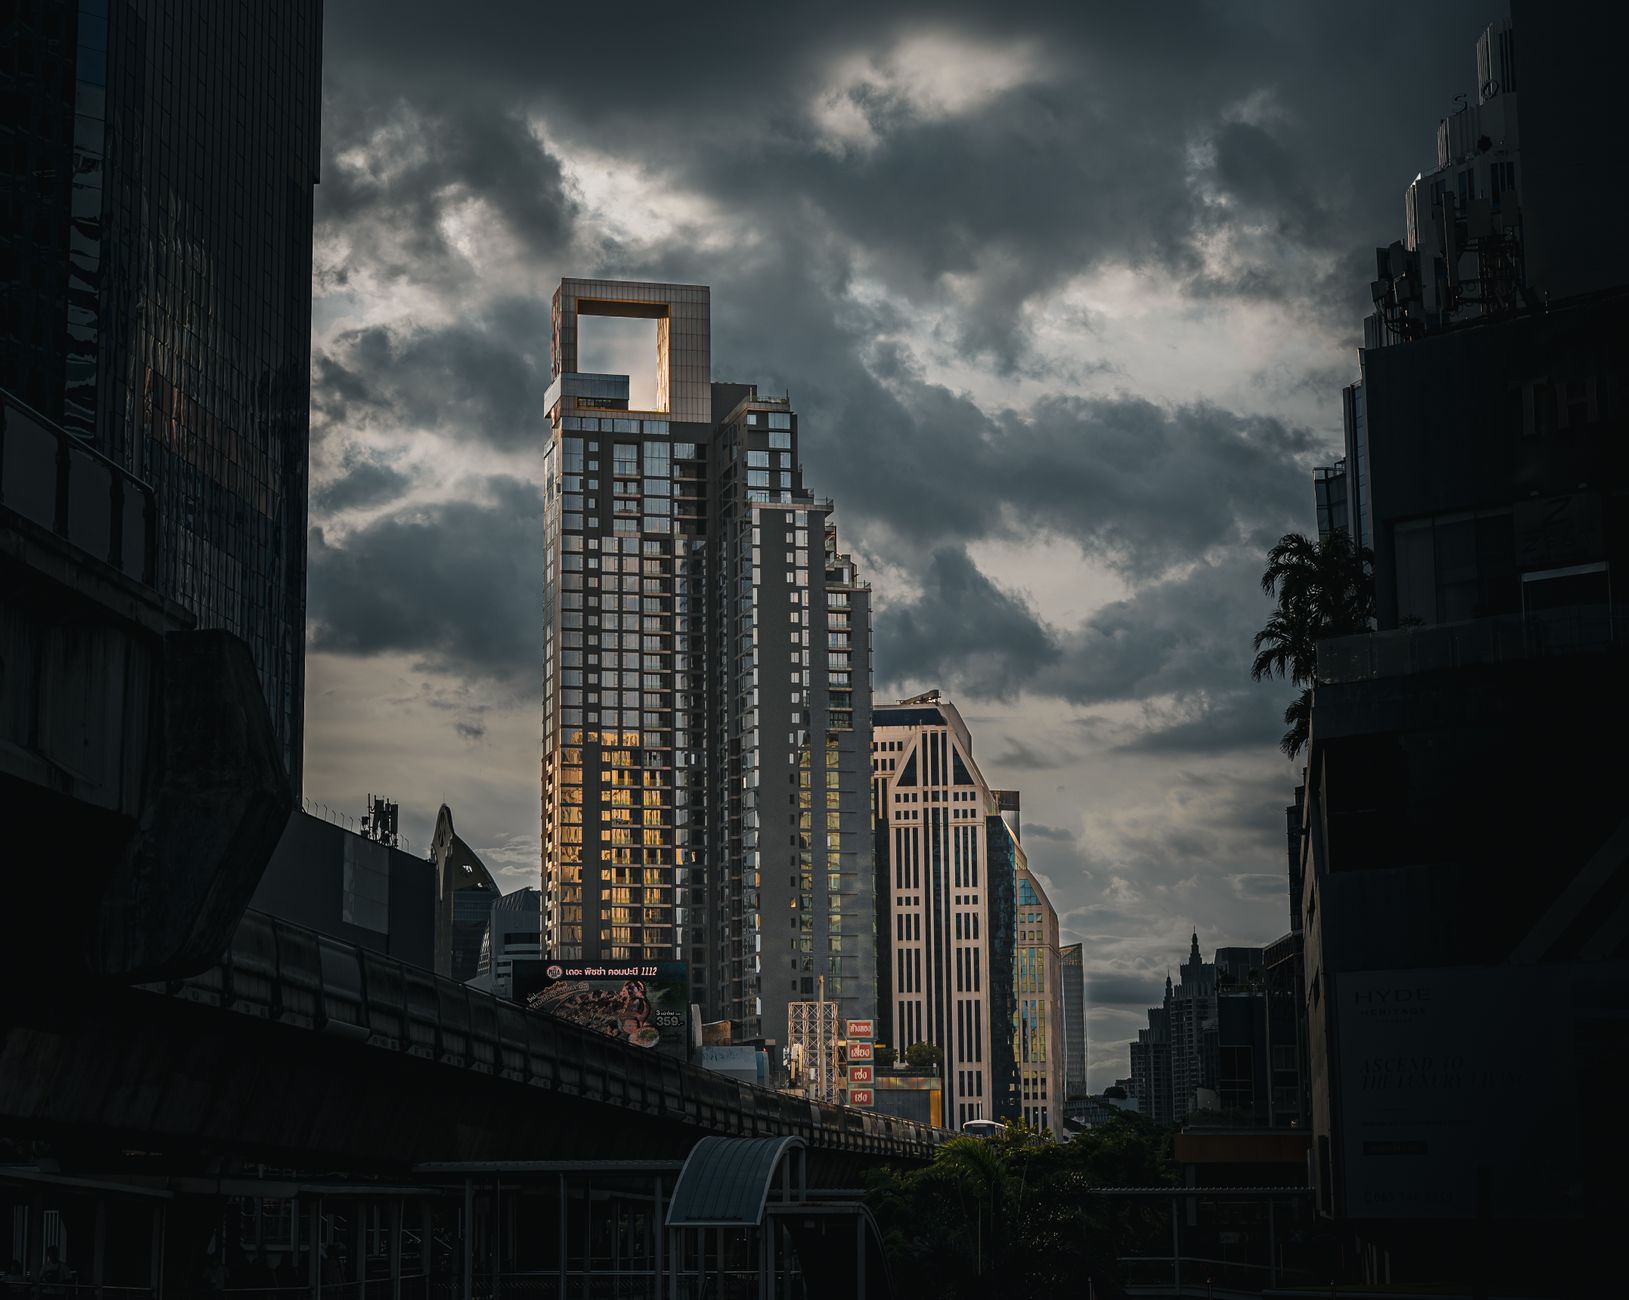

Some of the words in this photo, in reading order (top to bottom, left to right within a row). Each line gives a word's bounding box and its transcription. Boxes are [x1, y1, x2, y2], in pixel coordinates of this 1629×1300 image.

[584, 967, 606, 976] พิซซ่า
[641, 967, 658, 976] 1112
[1354, 988, 1432, 1004] HYDE
[1359, 1056, 1433, 1074] ASCEND
[1442, 1055, 1465, 1071] TO
[1360, 1073, 1393, 1091] THE
[1397, 1071, 1465, 1090] LUXURY
